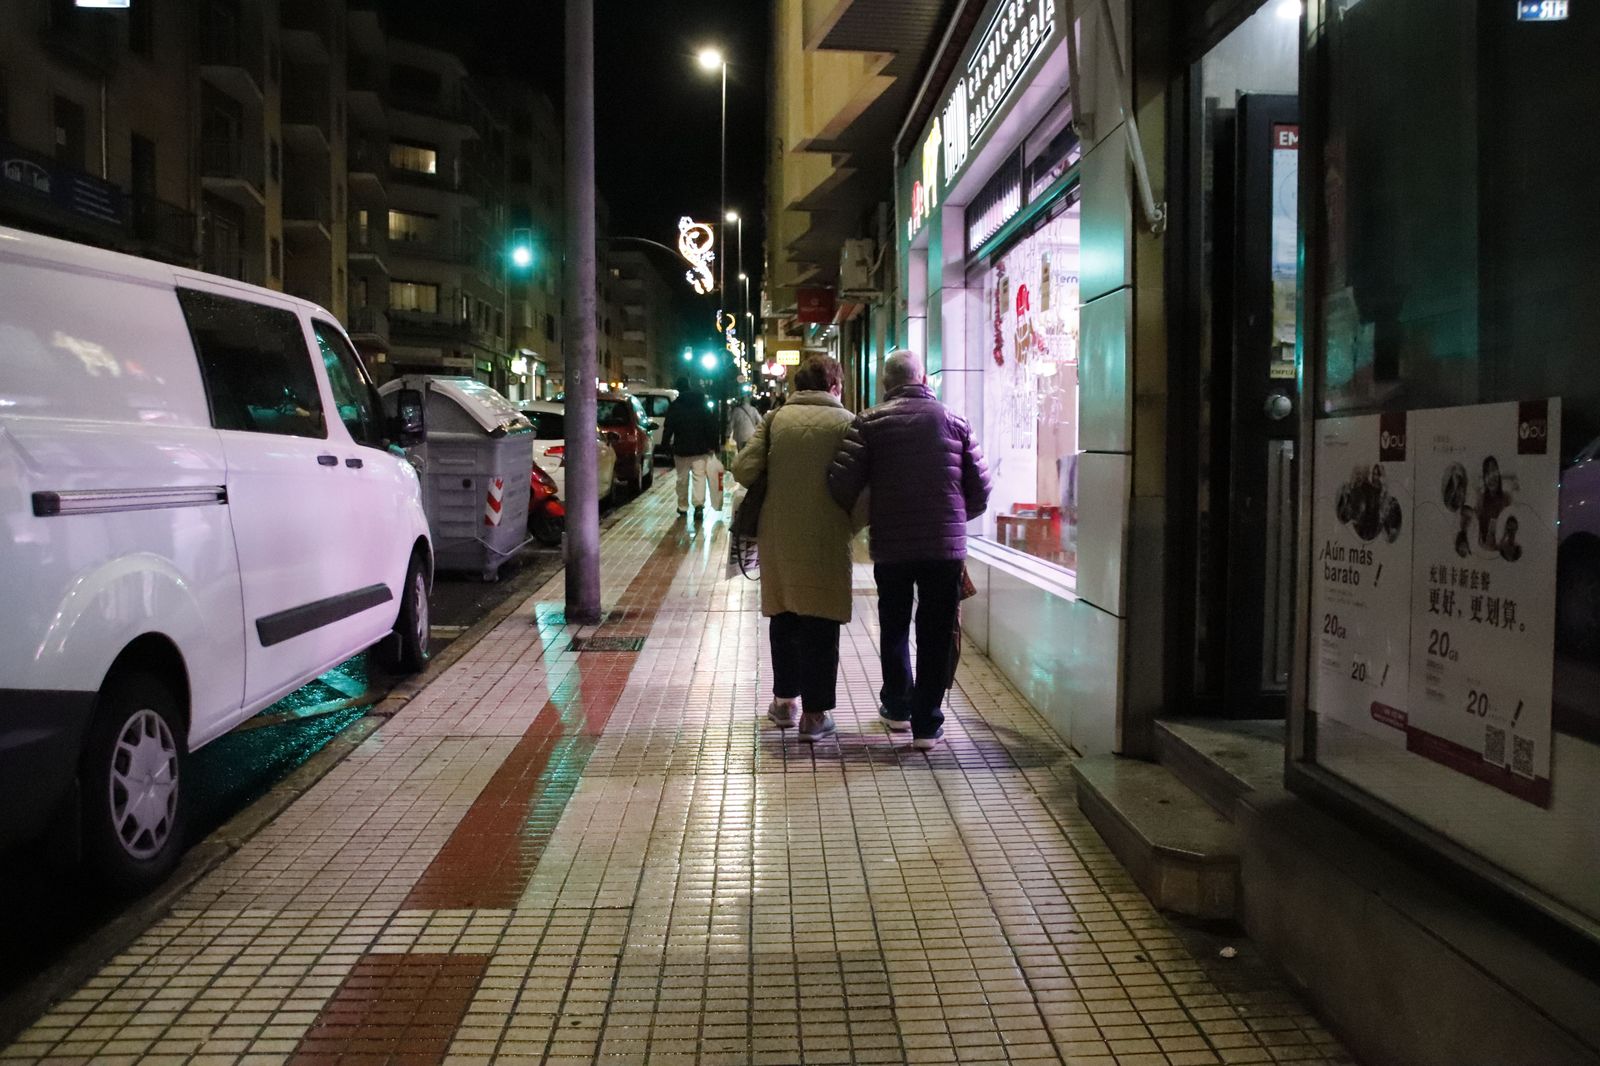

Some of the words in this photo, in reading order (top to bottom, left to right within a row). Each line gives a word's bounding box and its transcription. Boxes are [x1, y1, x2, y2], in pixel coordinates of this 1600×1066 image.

[968, 0, 1031, 99] CARNICER
[1349, 544, 1373, 566] más
[1351, 661, 1366, 682] 20
[1466, 689, 1489, 718] 20
